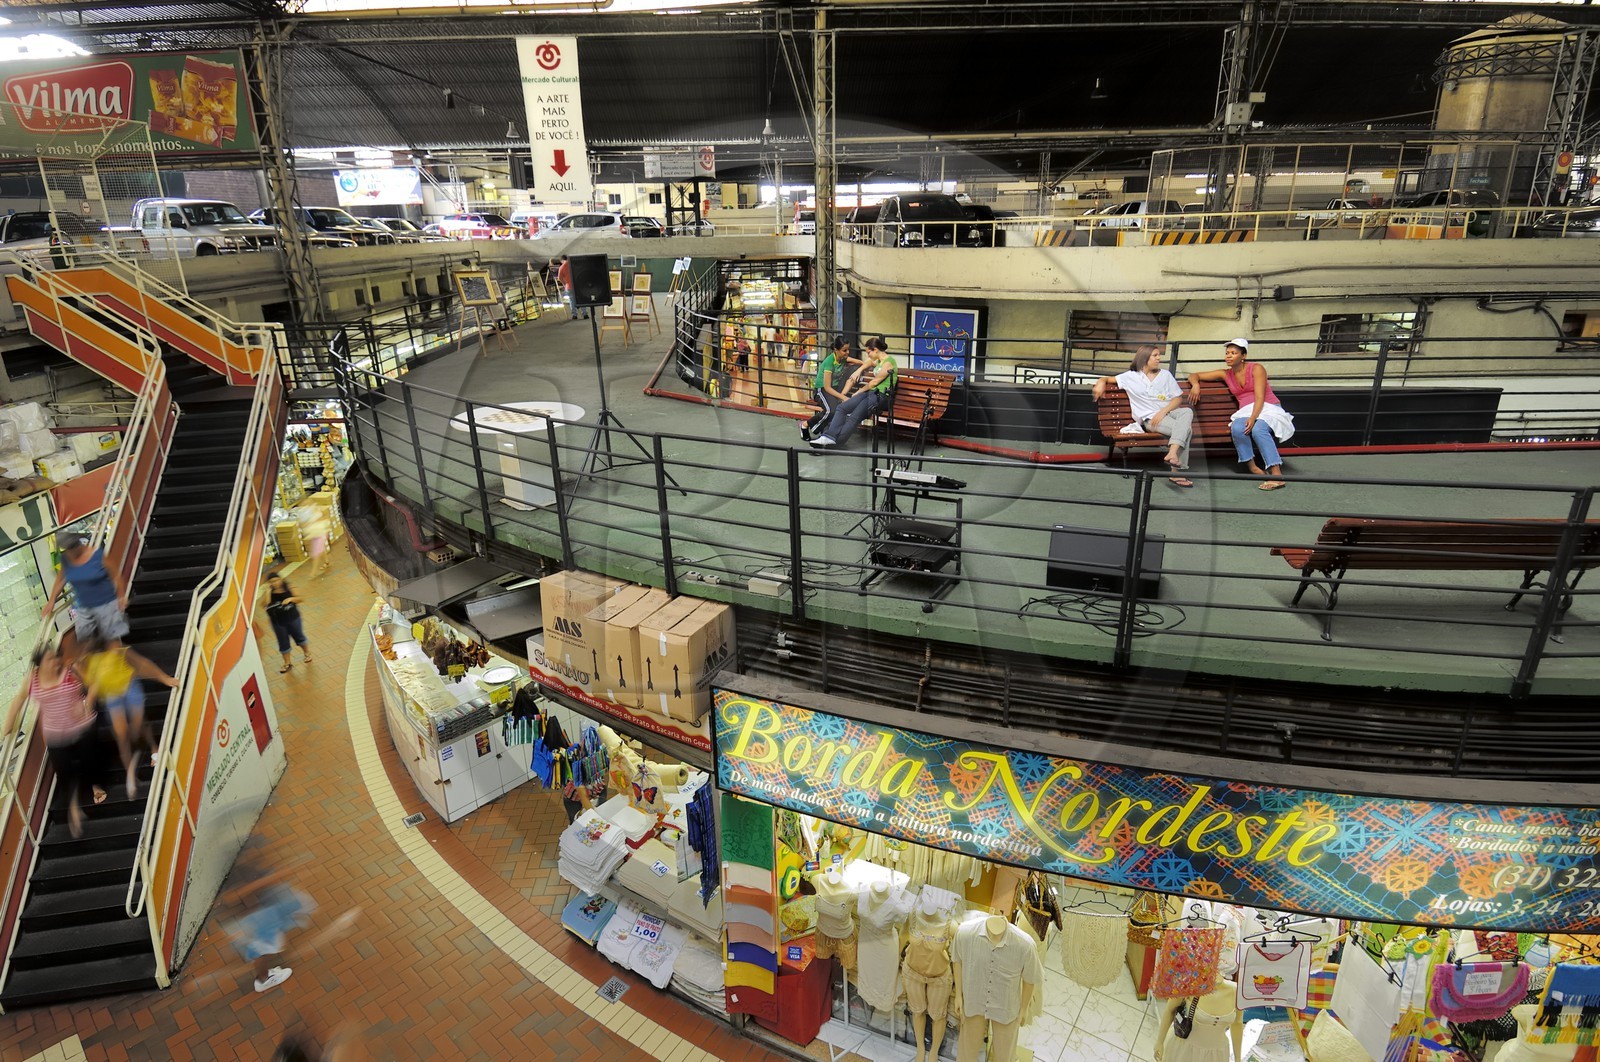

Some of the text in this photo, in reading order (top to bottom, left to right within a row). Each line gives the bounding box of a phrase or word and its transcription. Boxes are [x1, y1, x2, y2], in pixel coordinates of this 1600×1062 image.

[521, 76, 550, 84] Mercado
[13, 80, 123, 120] Vilma
[537, 94, 570, 103] A ARTE
[542, 107, 566, 116] MAIS
[541, 119, 570, 128] PERTO
[535, 131, 546, 140] DE
[549, 129, 574, 140] VOCÊ
[48, 145, 71, 155] nos
[549, 182, 577, 192] AQUI.
[605, 703, 622, 717] Panos
[633, 716, 650, 728] Prato
[656, 726, 680, 739] Sacaria
[681, 735, 692, 743] em
[693, 739, 711, 750] Geral
[206, 724, 251, 794] MERCADO CENTRAL
[722, 700, 1336, 866] Borda Nordeste
[730, 770, 1042, 857] De mãos dadas com a cultura nordestina
[1524, 825, 1572, 837] mesa,
[1577, 824, 1600, 837] ba
[1543, 844, 1552, 854] a
[653, 862, 669, 875] 1,40
[1493, 865, 1551, 891] (31)
[1432, 893, 1503, 915] Lojas:
[1508, 898, 1526, 917] 3,
[635, 926, 656, 938] 1,00
